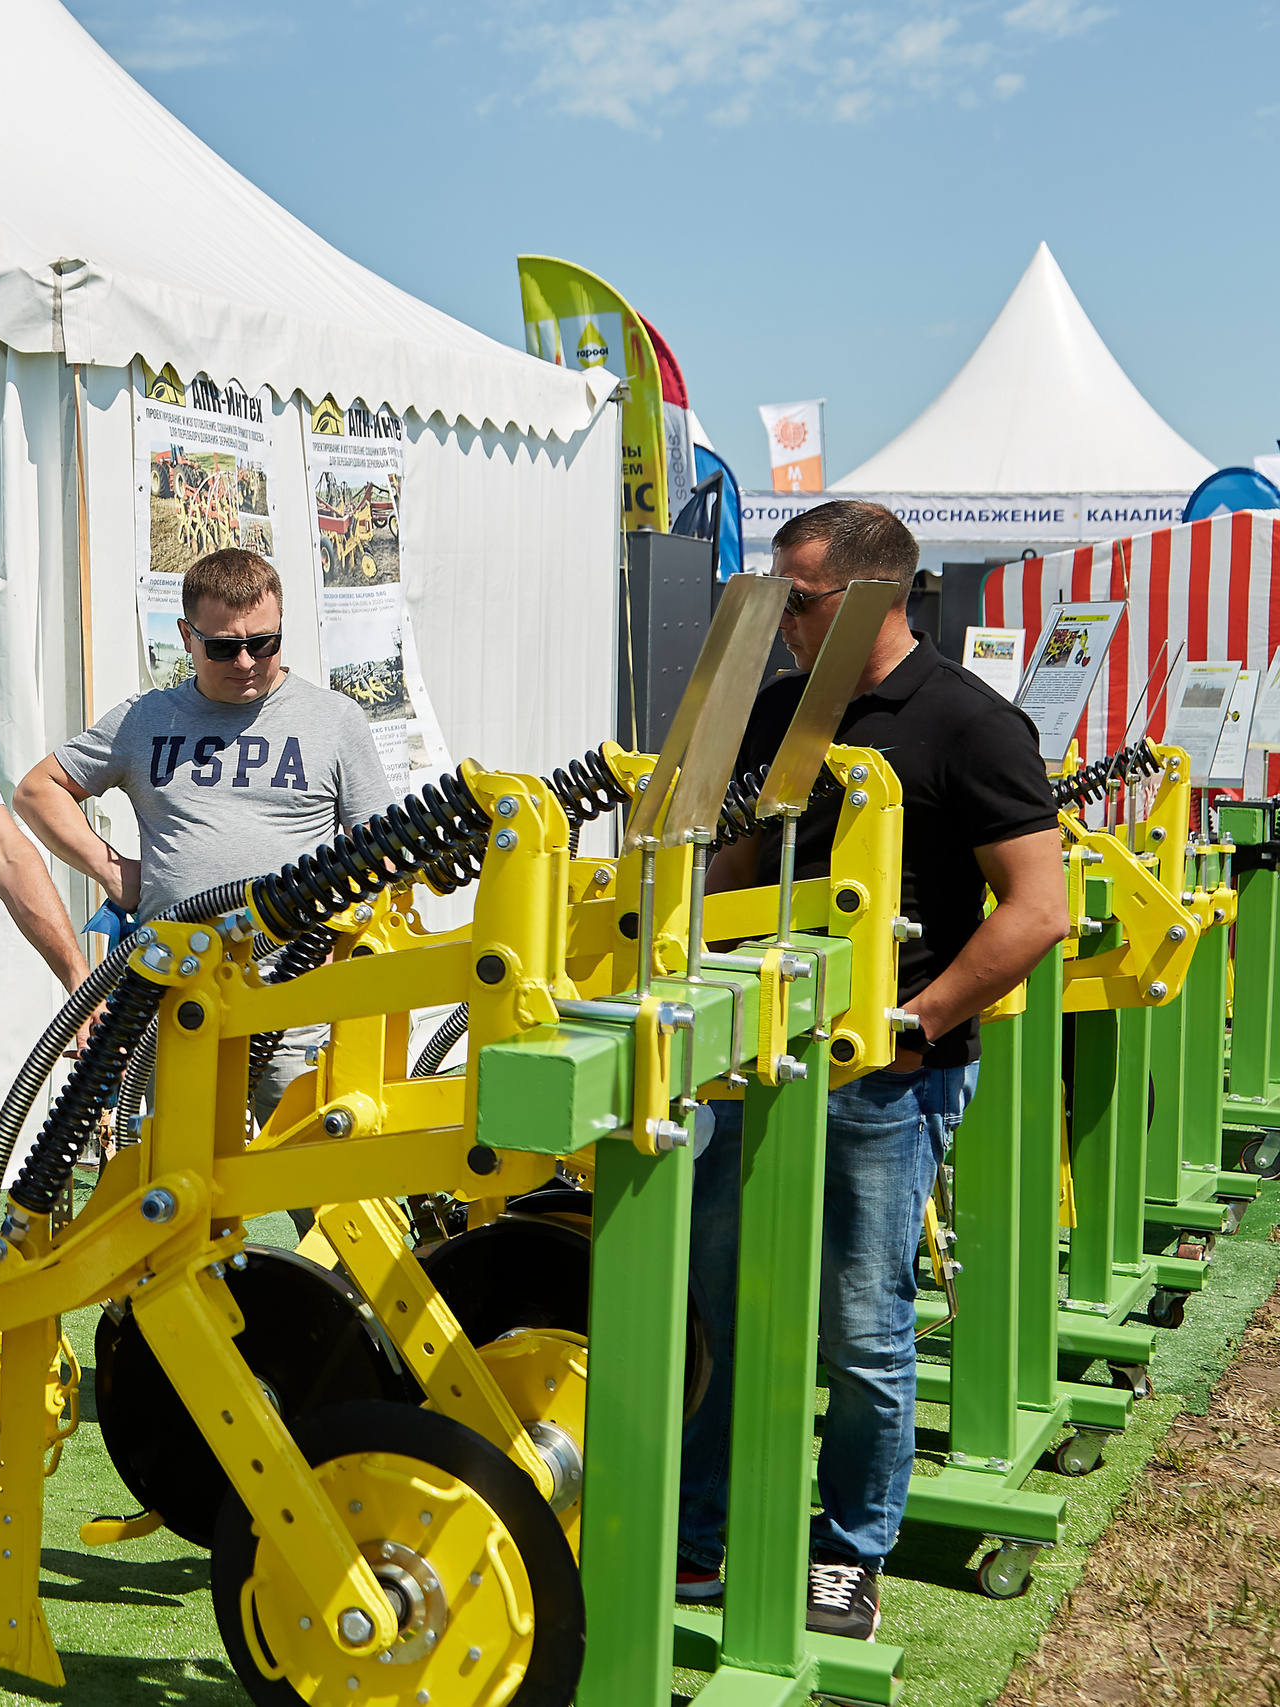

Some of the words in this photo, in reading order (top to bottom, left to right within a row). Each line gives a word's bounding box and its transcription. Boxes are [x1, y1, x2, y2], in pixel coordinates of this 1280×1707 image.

[577, 347, 608, 358] rapool
[667, 434, 688, 501] seeds
[150, 735, 309, 791] USPA
